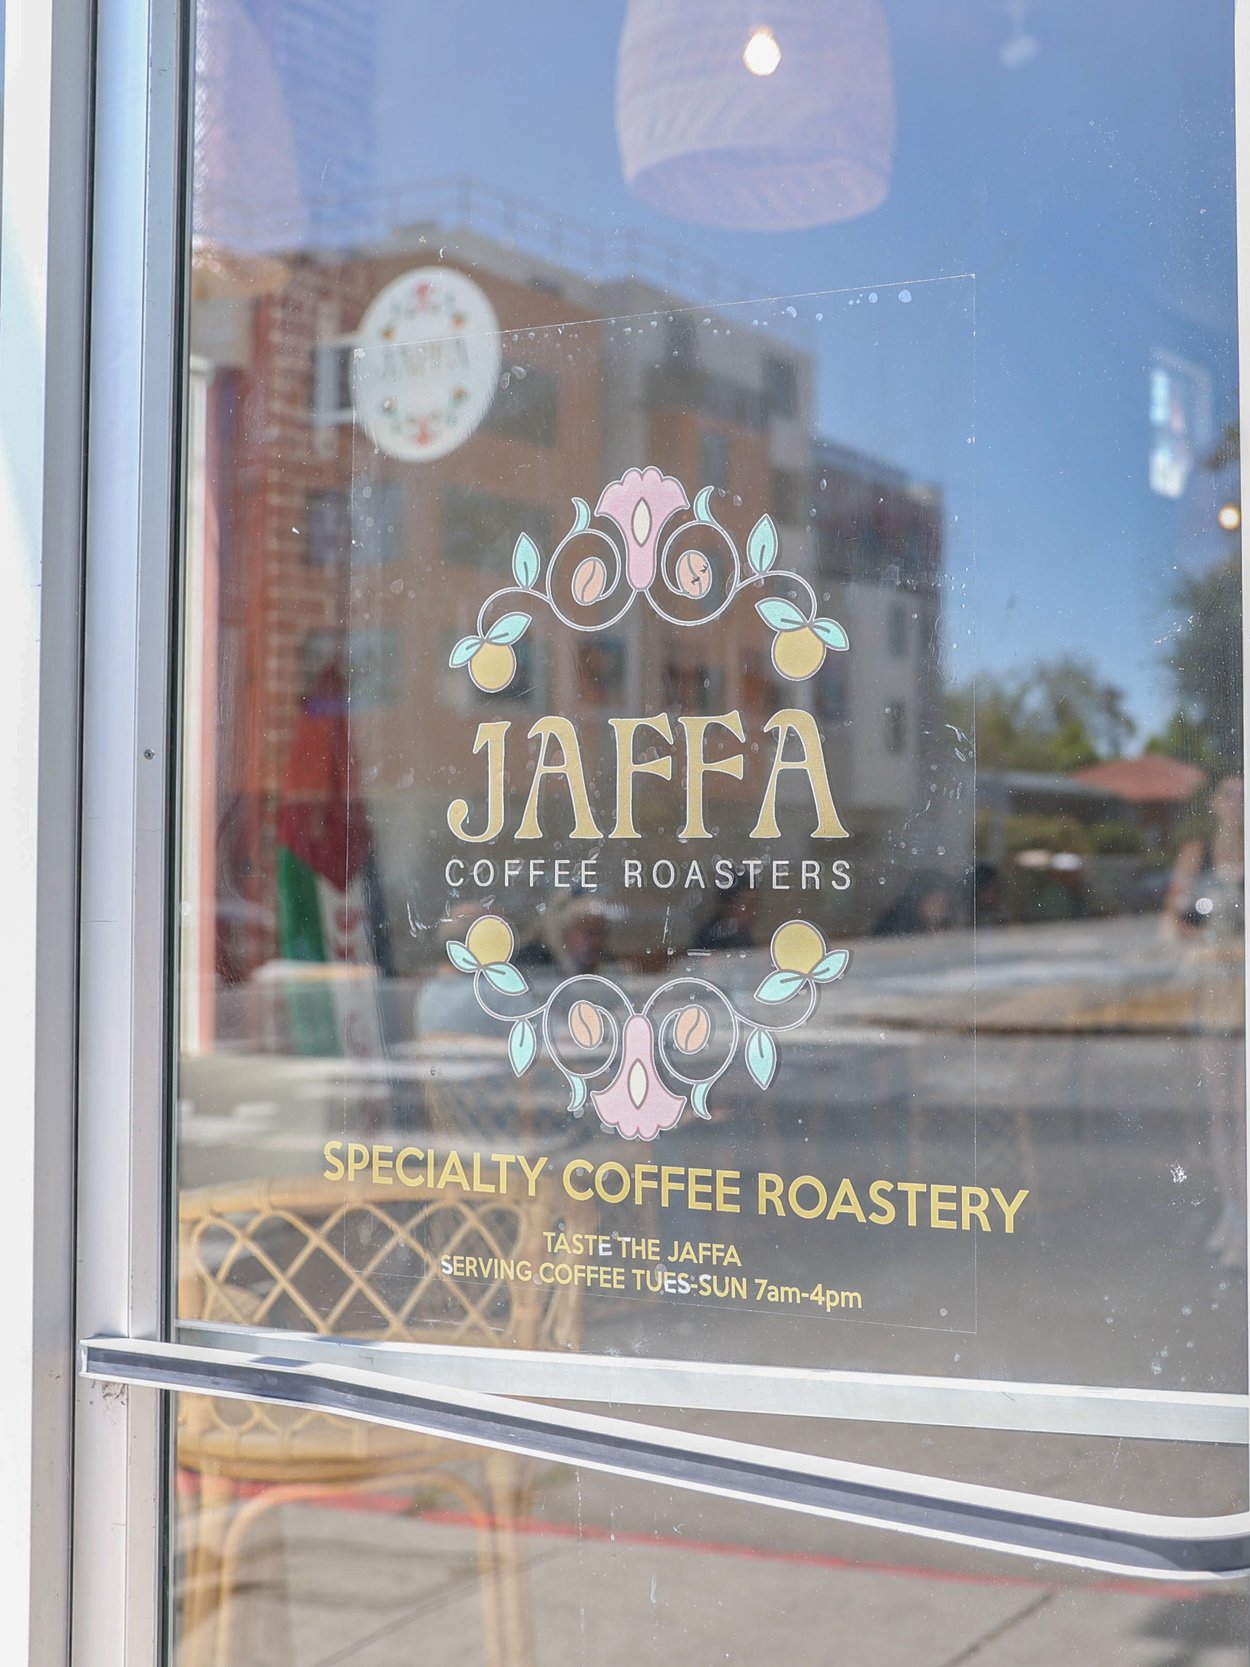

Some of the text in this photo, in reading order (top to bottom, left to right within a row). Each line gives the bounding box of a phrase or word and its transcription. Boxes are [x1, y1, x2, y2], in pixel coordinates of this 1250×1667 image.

[446, 708, 850, 843] JAFFA
[445, 859, 853, 890] COFFEE ROASTERS
[322, 1140, 1030, 1234] SPECIALTY COFFEE ROASTERY
[543, 1231, 742, 1267] TASTE THE JAFFA
[440, 1254, 863, 1312] SERVING COFFEE TUES-SUN 7am-4pm
